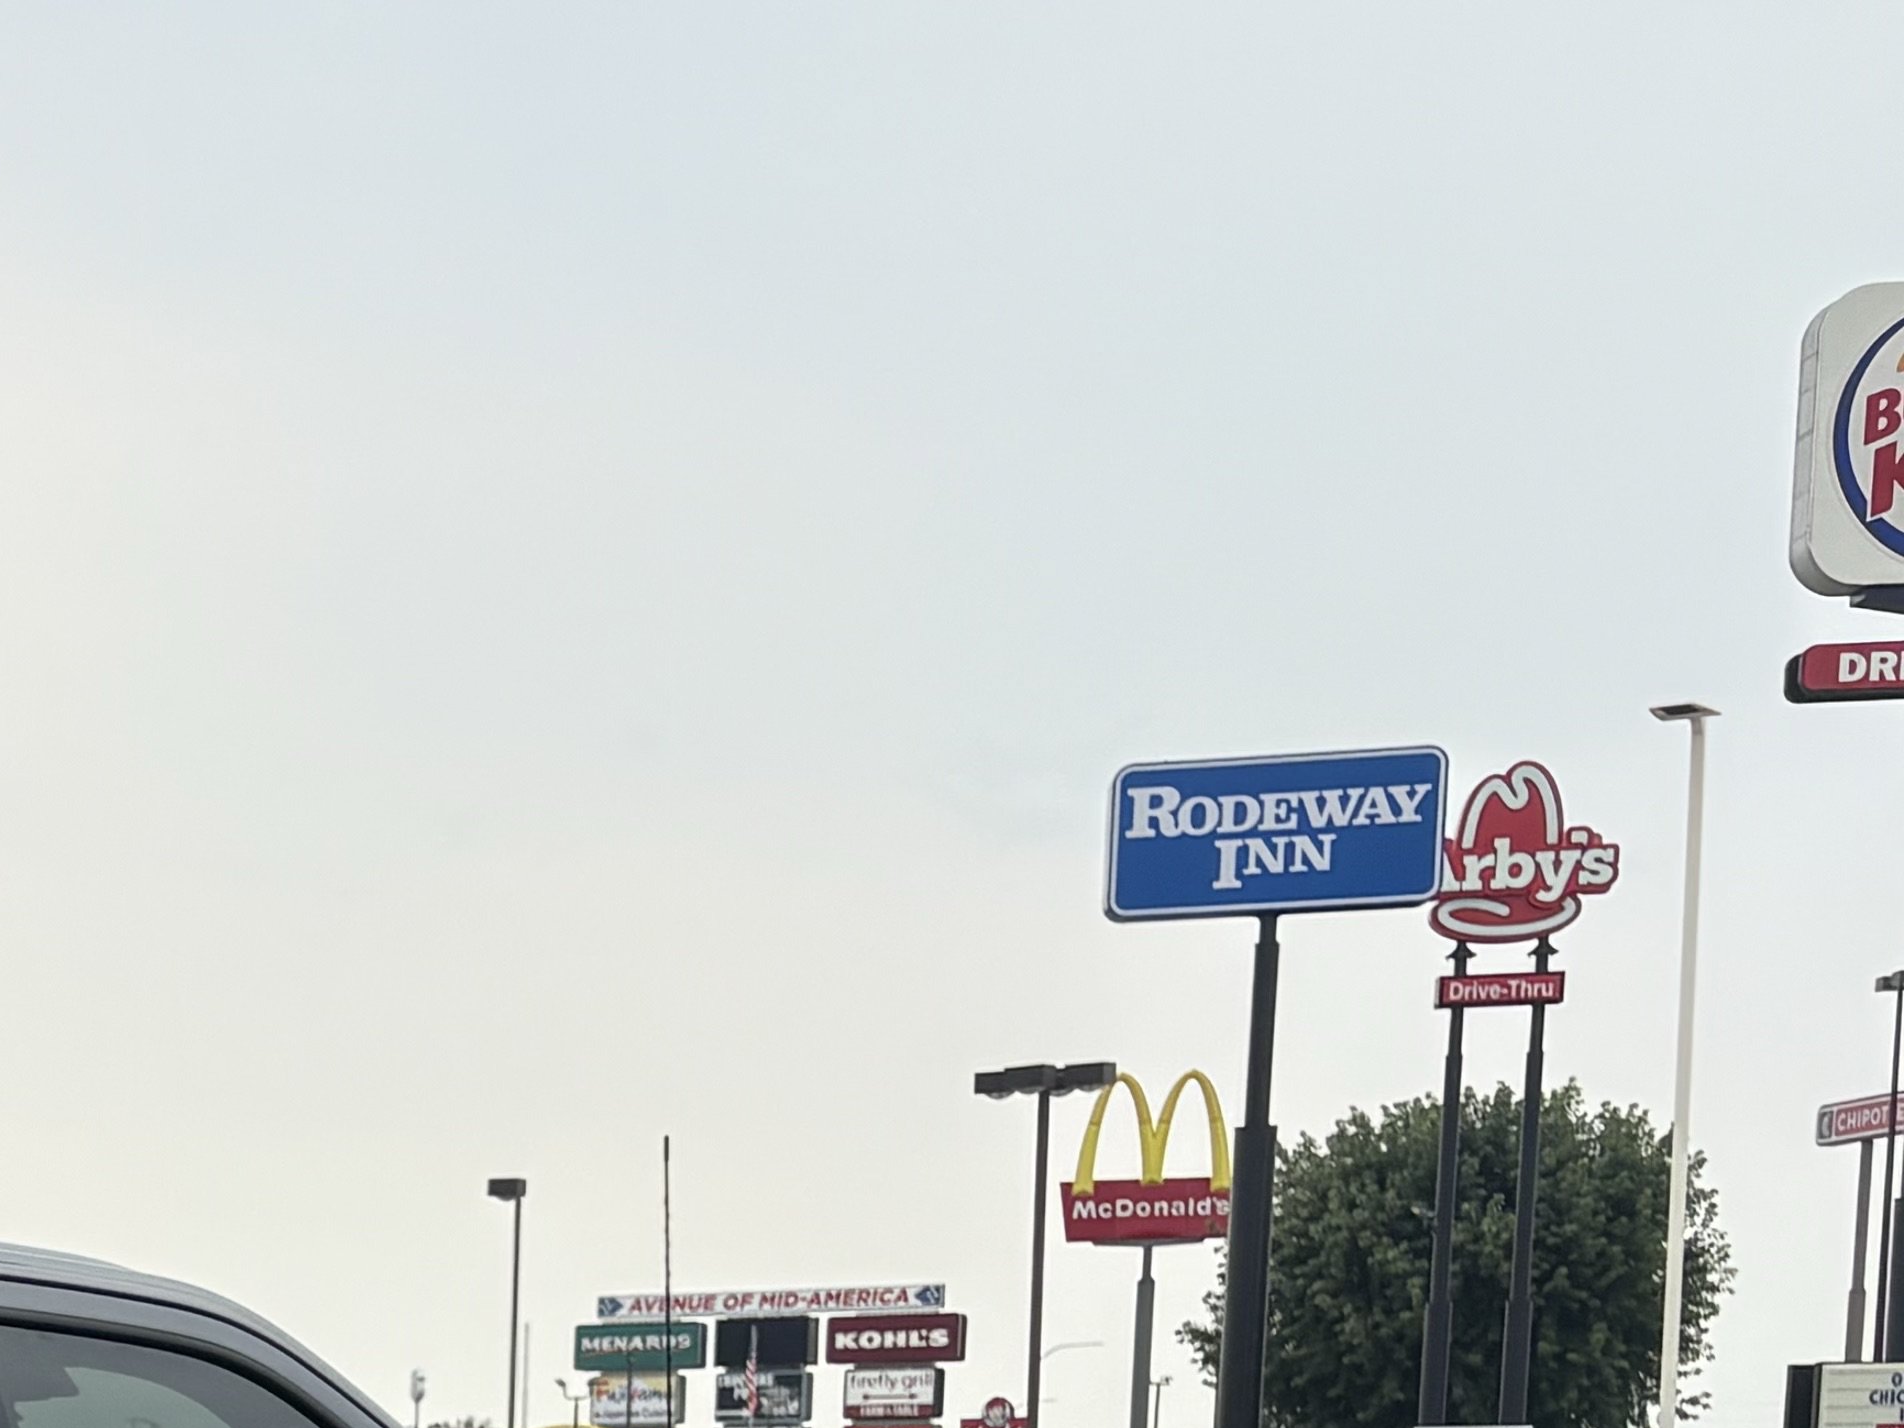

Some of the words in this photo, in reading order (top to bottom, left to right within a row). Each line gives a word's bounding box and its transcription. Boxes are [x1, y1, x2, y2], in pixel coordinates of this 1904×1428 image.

[1125, 783, 1432, 839] RODEWAY
[1212, 834, 1337, 889] INN
[1449, 979, 1553, 1000] Drive-Thru
[1837, 1102, 1904, 1132] CHIPOTE
[1072, 1197, 1230, 1219] McDonald's
[723, 1292, 754, 1311] OF
[759, 1286, 910, 1309] MID-AMERICA
[581, 1333, 691, 1352] MENARDS
[834, 1328, 949, 1349] KOHL'S
